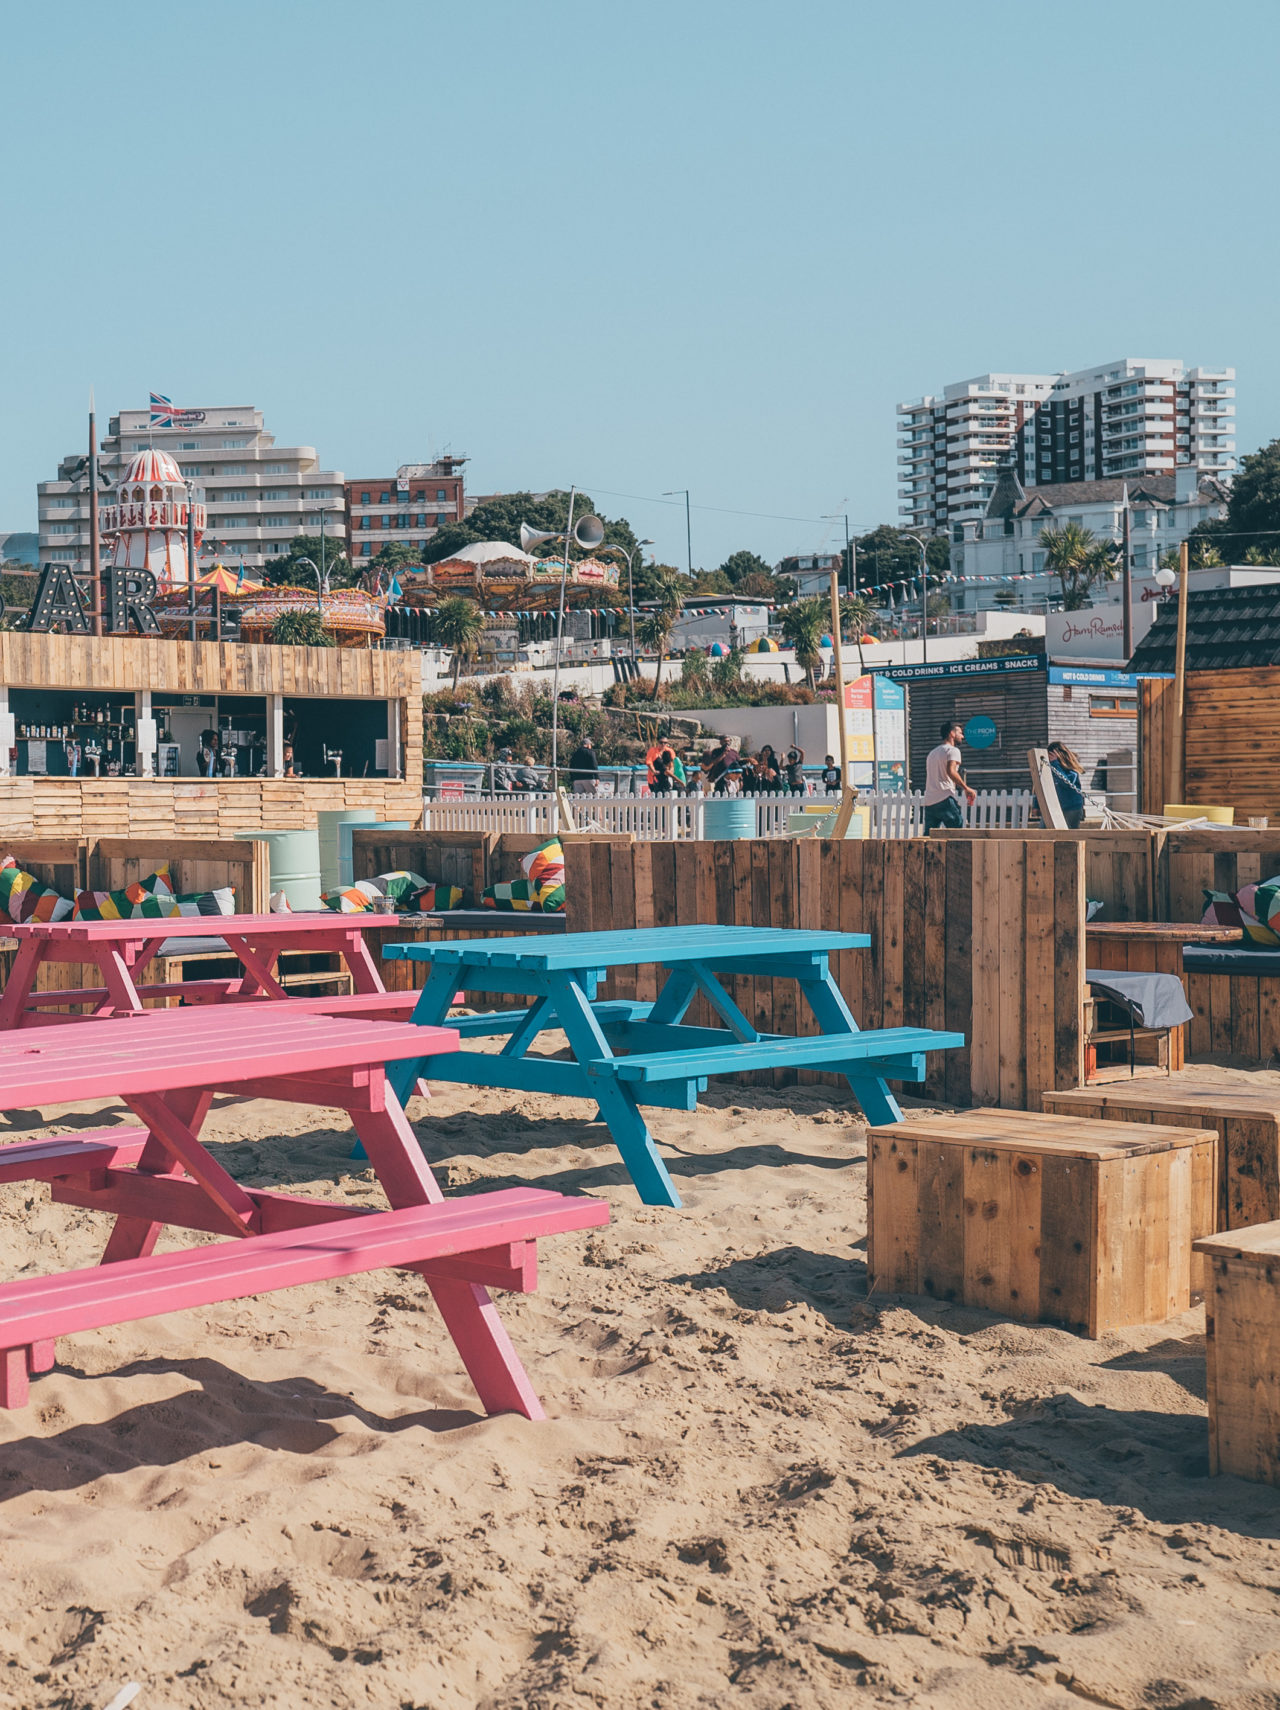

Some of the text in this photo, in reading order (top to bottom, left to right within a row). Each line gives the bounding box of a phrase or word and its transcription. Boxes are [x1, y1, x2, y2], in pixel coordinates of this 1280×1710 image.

[1062, 621, 1093, 642] Harry
[891, 668, 914, 677] COLD
[914, 666, 944, 676] DRINKS
[949, 665, 963, 673] ICE
[965, 662, 998, 672] CREAMS
[1004, 658, 1038, 669] SNACKS
